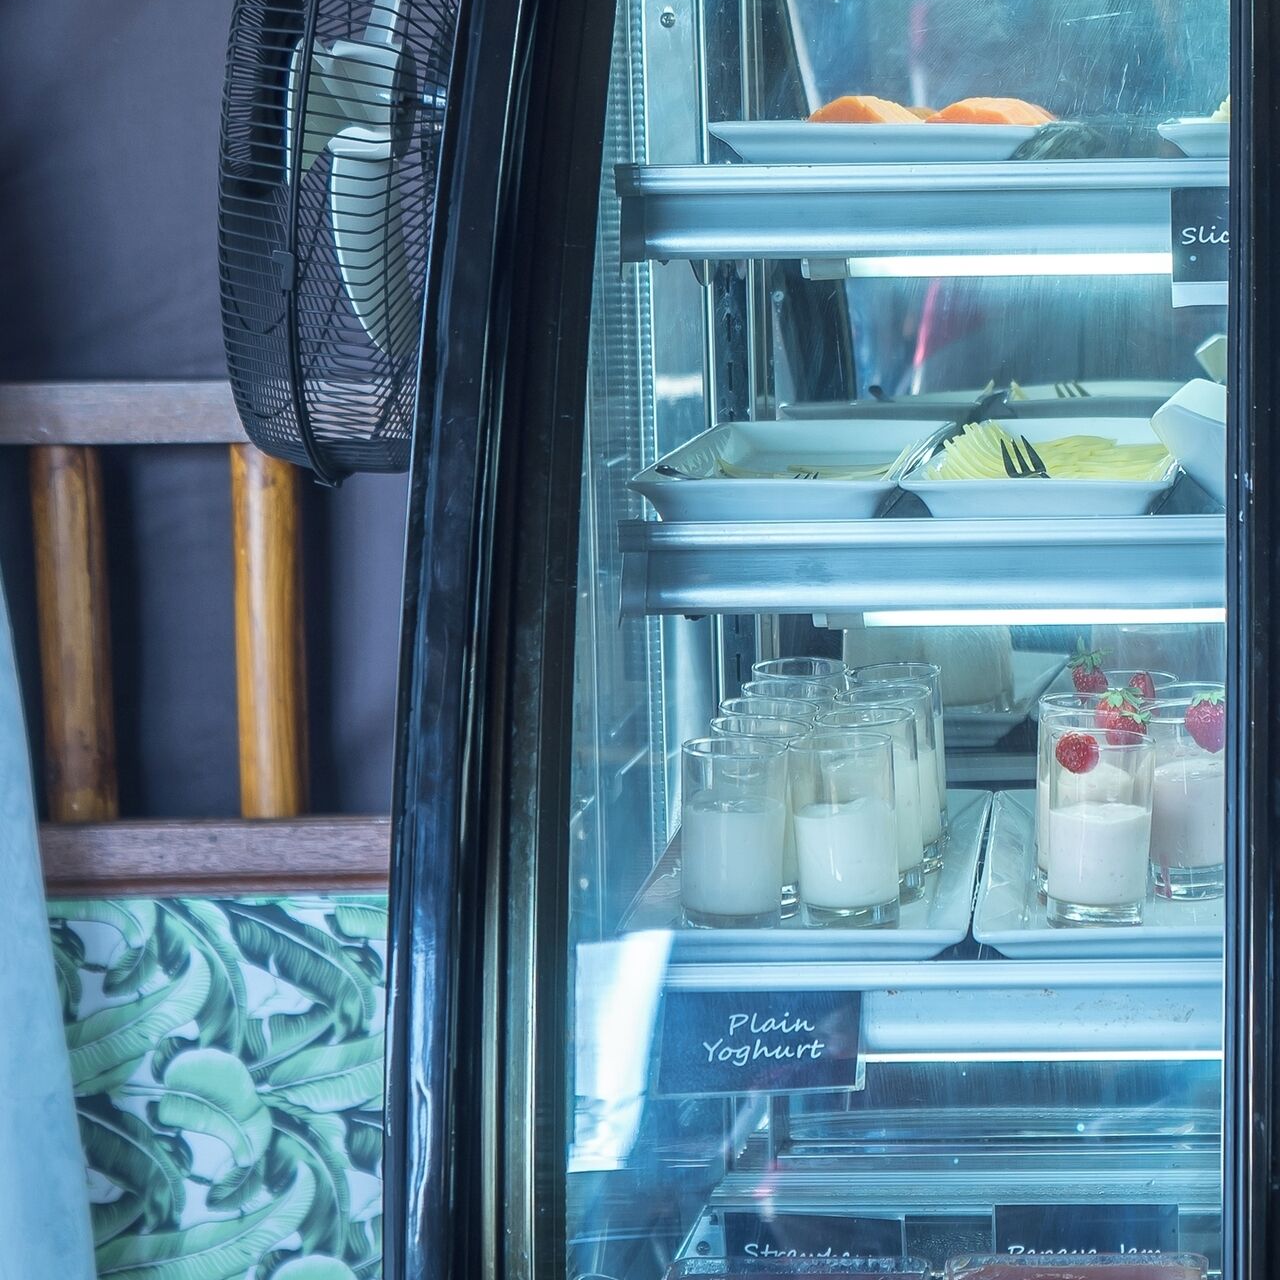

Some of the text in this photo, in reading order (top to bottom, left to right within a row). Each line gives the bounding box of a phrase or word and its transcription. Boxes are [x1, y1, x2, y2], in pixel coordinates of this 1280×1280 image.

[1182, 226, 1231, 245] Slic
[728, 1011, 816, 1036] Plain
[702, 1037, 826, 1067] Yoghurt
